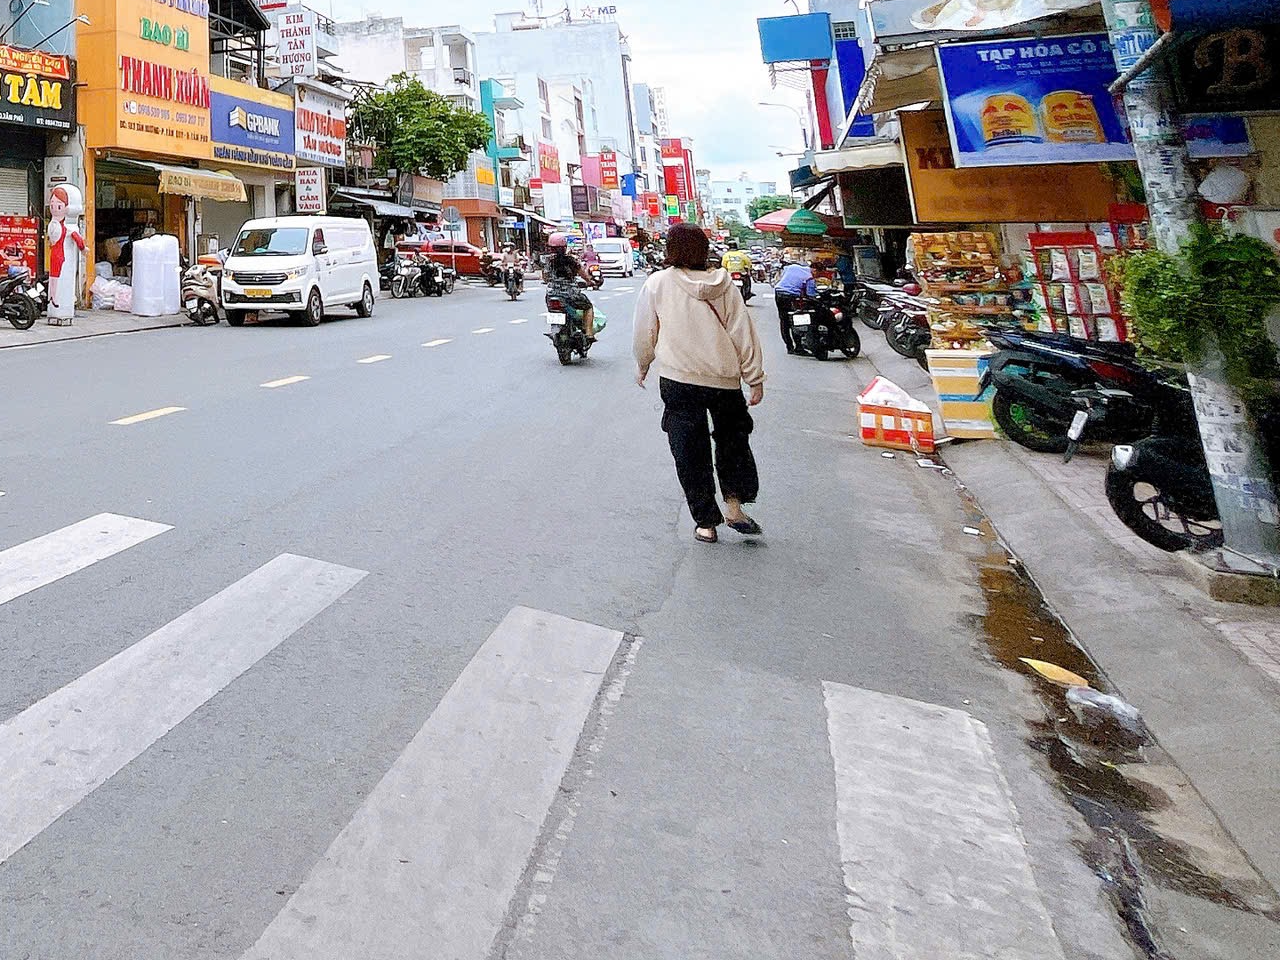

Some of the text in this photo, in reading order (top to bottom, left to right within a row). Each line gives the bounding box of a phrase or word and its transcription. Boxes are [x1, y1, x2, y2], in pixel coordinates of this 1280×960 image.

[597, 5, 617, 15] MB
[285, 14, 304, 25] KIM
[140, 17, 172, 46] BAO
[280, 25, 311, 39] THÀNH
[287, 38, 305, 51] TÂN
[282, 52, 312, 65] HƯƠNG
[976, 48, 1015, 64] TẠP
[290, 65, 305, 75] 187
[119, 55, 173, 101] THANH
[246, 113, 280, 136] GPBANK
[297, 107, 315, 133] KIM
